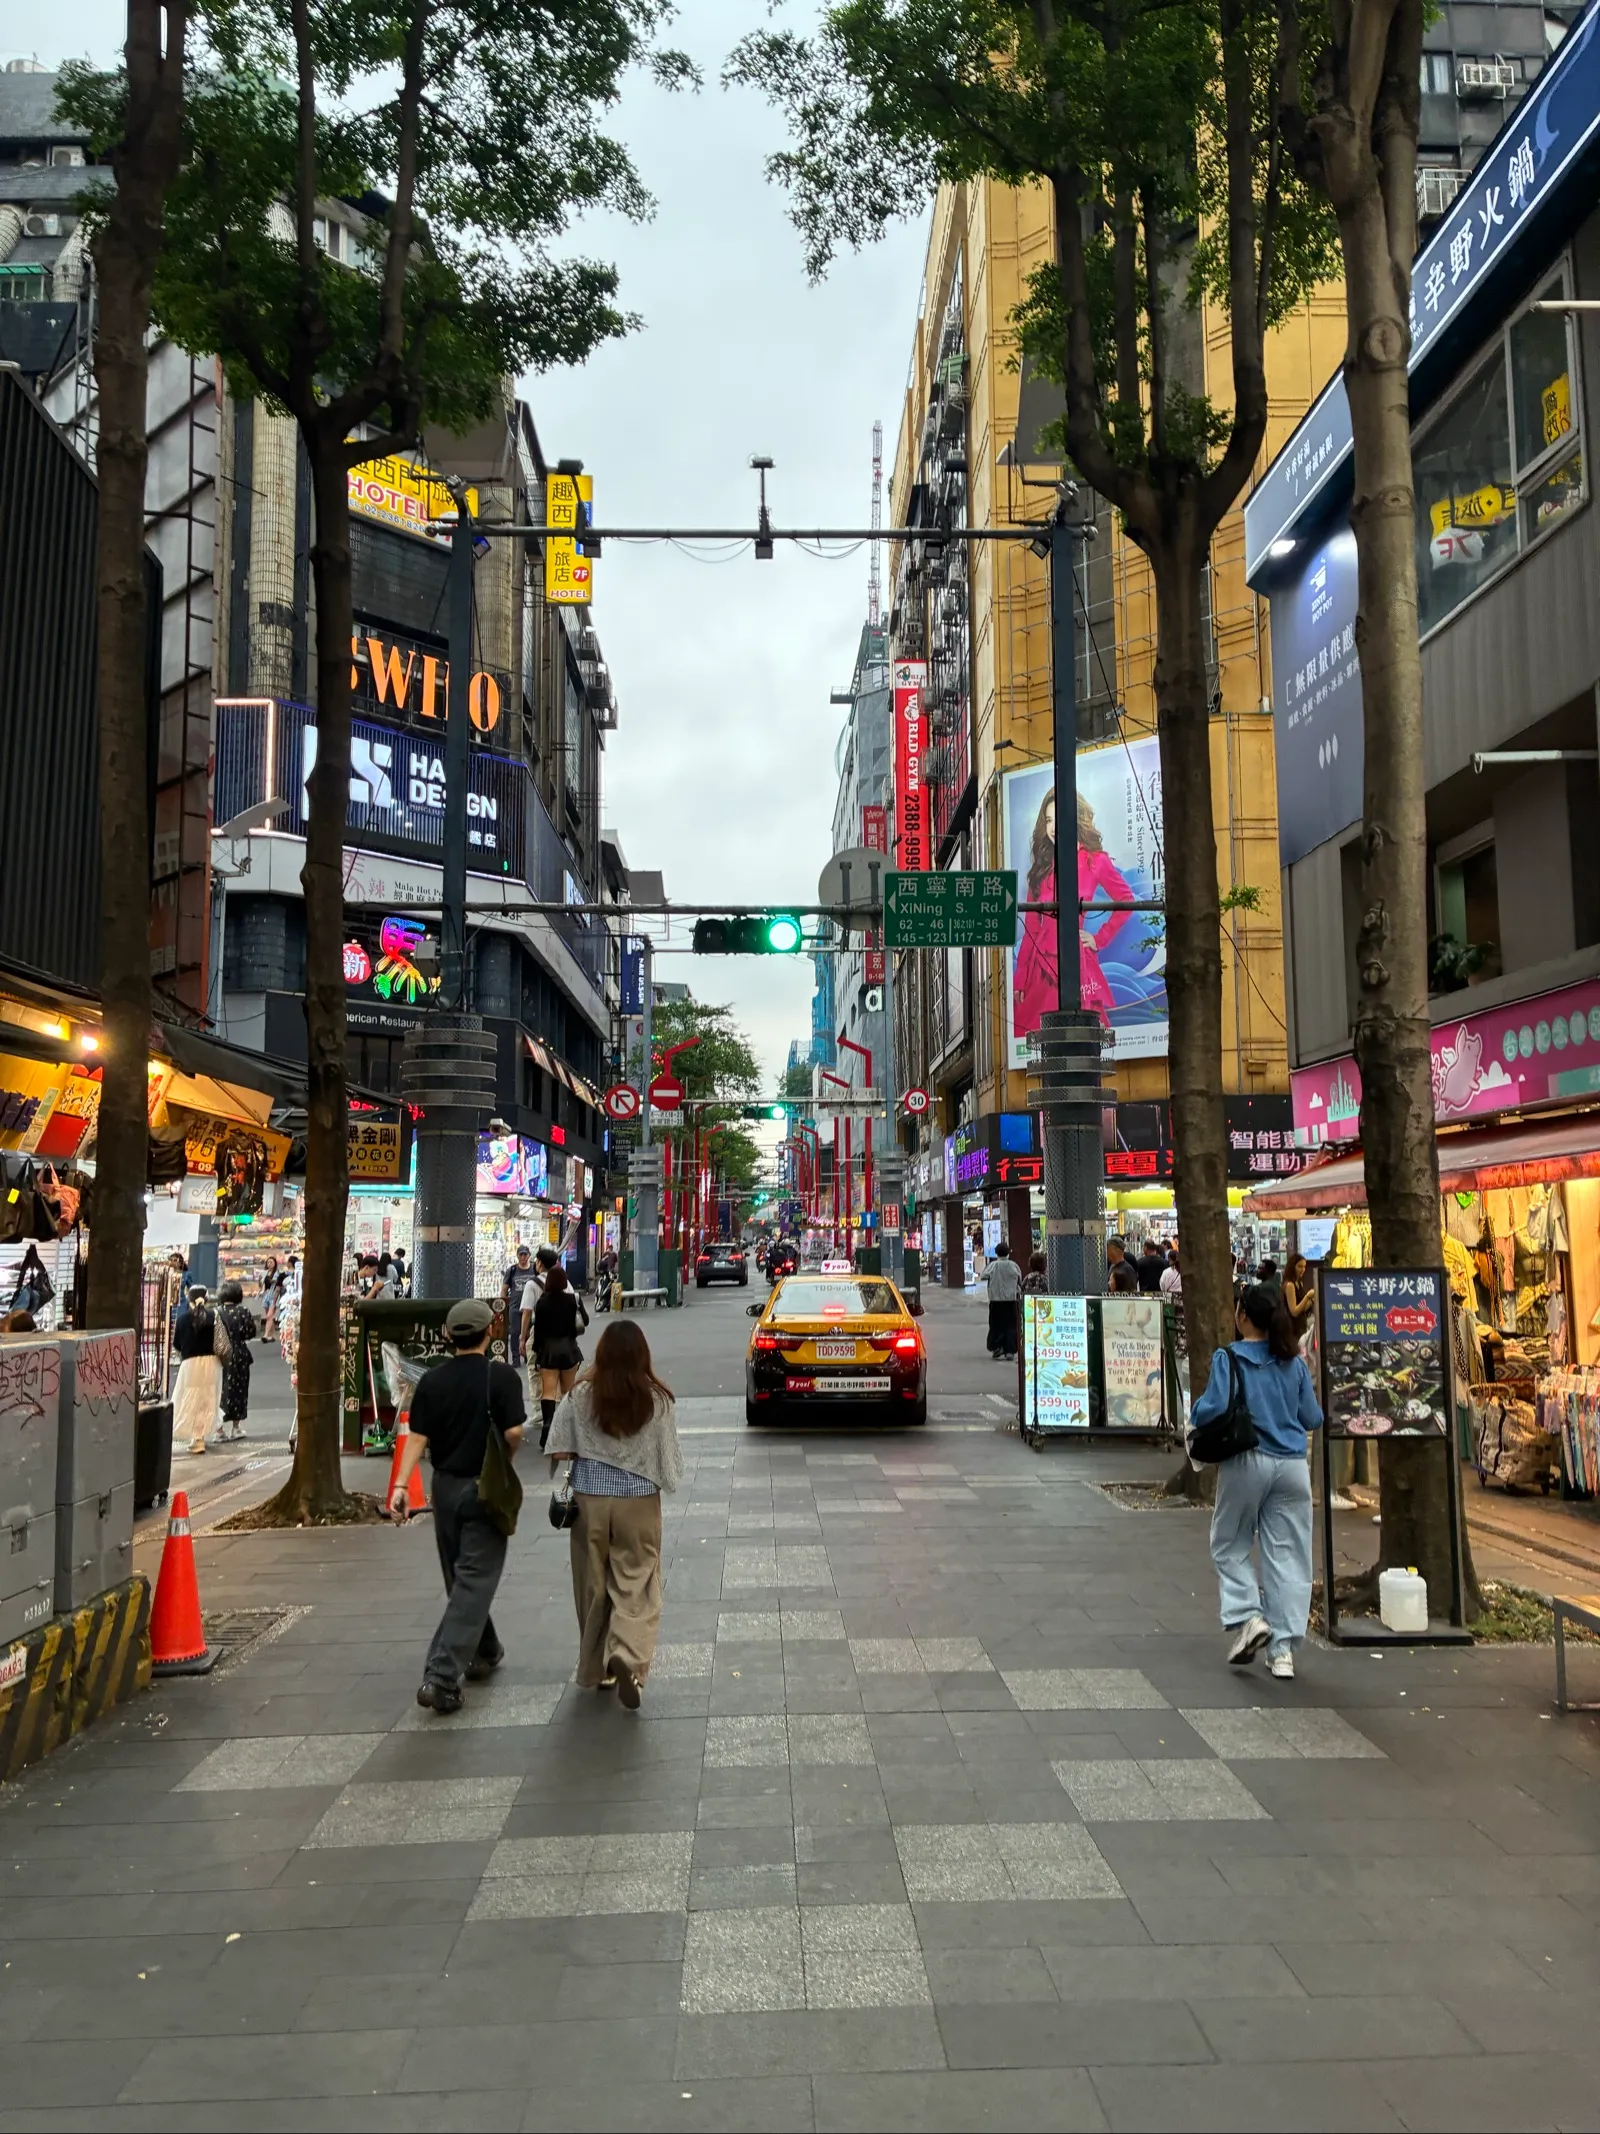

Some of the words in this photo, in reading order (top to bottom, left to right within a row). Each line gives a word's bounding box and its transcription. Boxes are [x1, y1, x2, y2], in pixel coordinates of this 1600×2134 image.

[1424, 136, 1535, 313] 辛野火鍋
[348, 474, 429, 522] HOTEL
[574, 569, 589, 580] 7F
[550, 589, 589, 599] HOTEL
[907, 756, 920, 792] GYM
[409, 778, 497, 821] DEGN
[416, 884, 431, 895] Hot
[897, 876, 1004, 898] 西寧南路
[899, 902, 944, 917] XiNing
[955, 903, 968, 914] S.
[980, 902, 1002, 914] Rd.
[899, 920, 913, 930] 62
[929, 919, 944, 930] 46
[910, 1096, 924, 1106] 30
[1360, 1276, 1436, 1297] 辛野火鍋
[1340, 1323, 1378, 1336] 吃到飽
[1111, 1341, 1128, 1350] Foot
[1064, 1349, 1080, 1360] up
[1065, 1399, 1081, 1411] up
[1028, 1412, 1048, 1420] Trn
